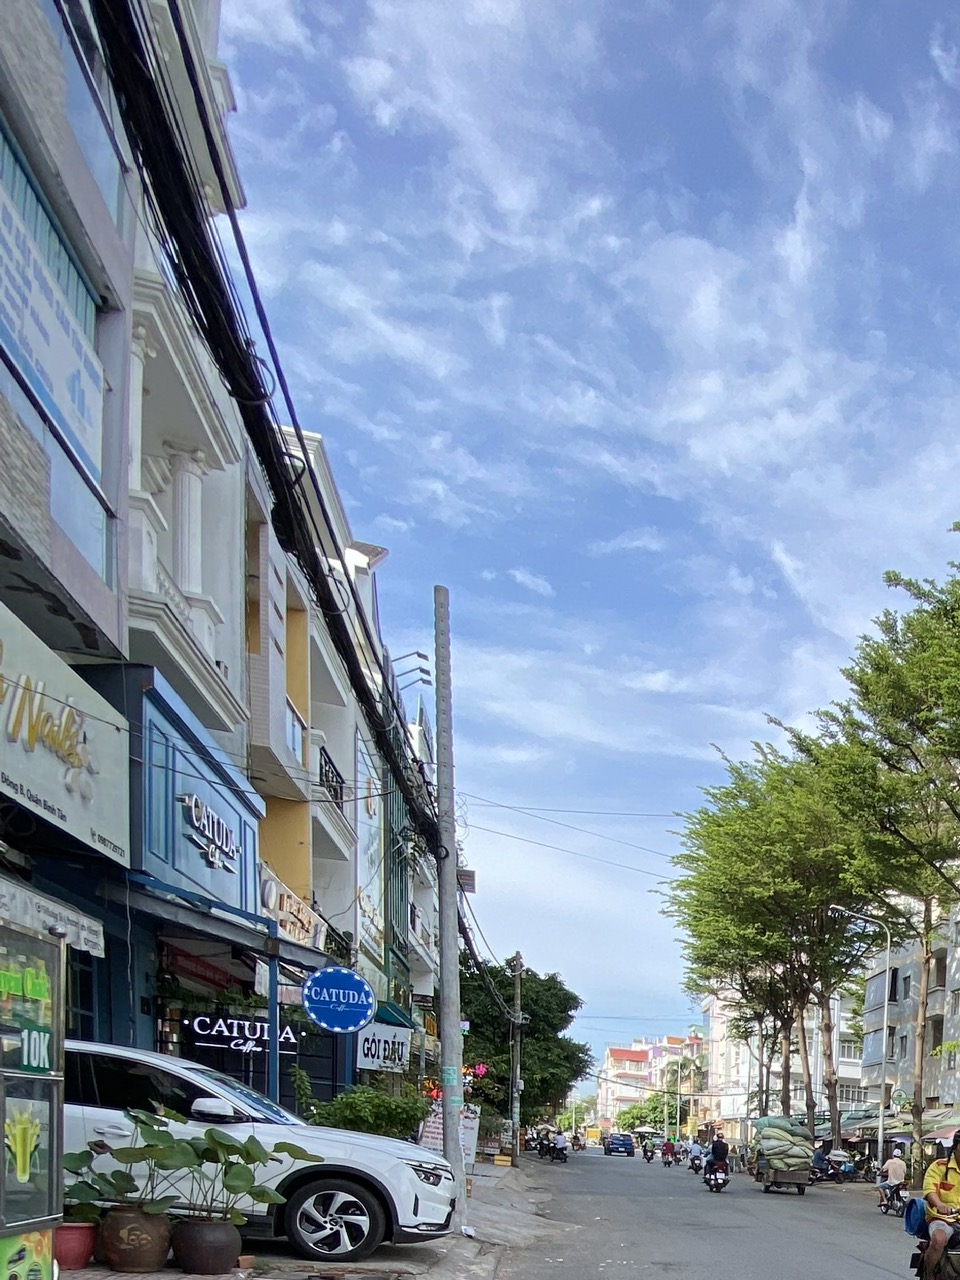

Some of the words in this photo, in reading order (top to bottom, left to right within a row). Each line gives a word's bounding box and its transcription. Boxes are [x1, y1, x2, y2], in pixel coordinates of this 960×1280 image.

[192, 794, 238, 861] CATUDA
[311, 987, 368, 1005] CATUDA
[21, 1029, 50, 1069] 10K
[230, 1039, 263, 1053] Coffee
[363, 1032, 381, 1065] GỘI
